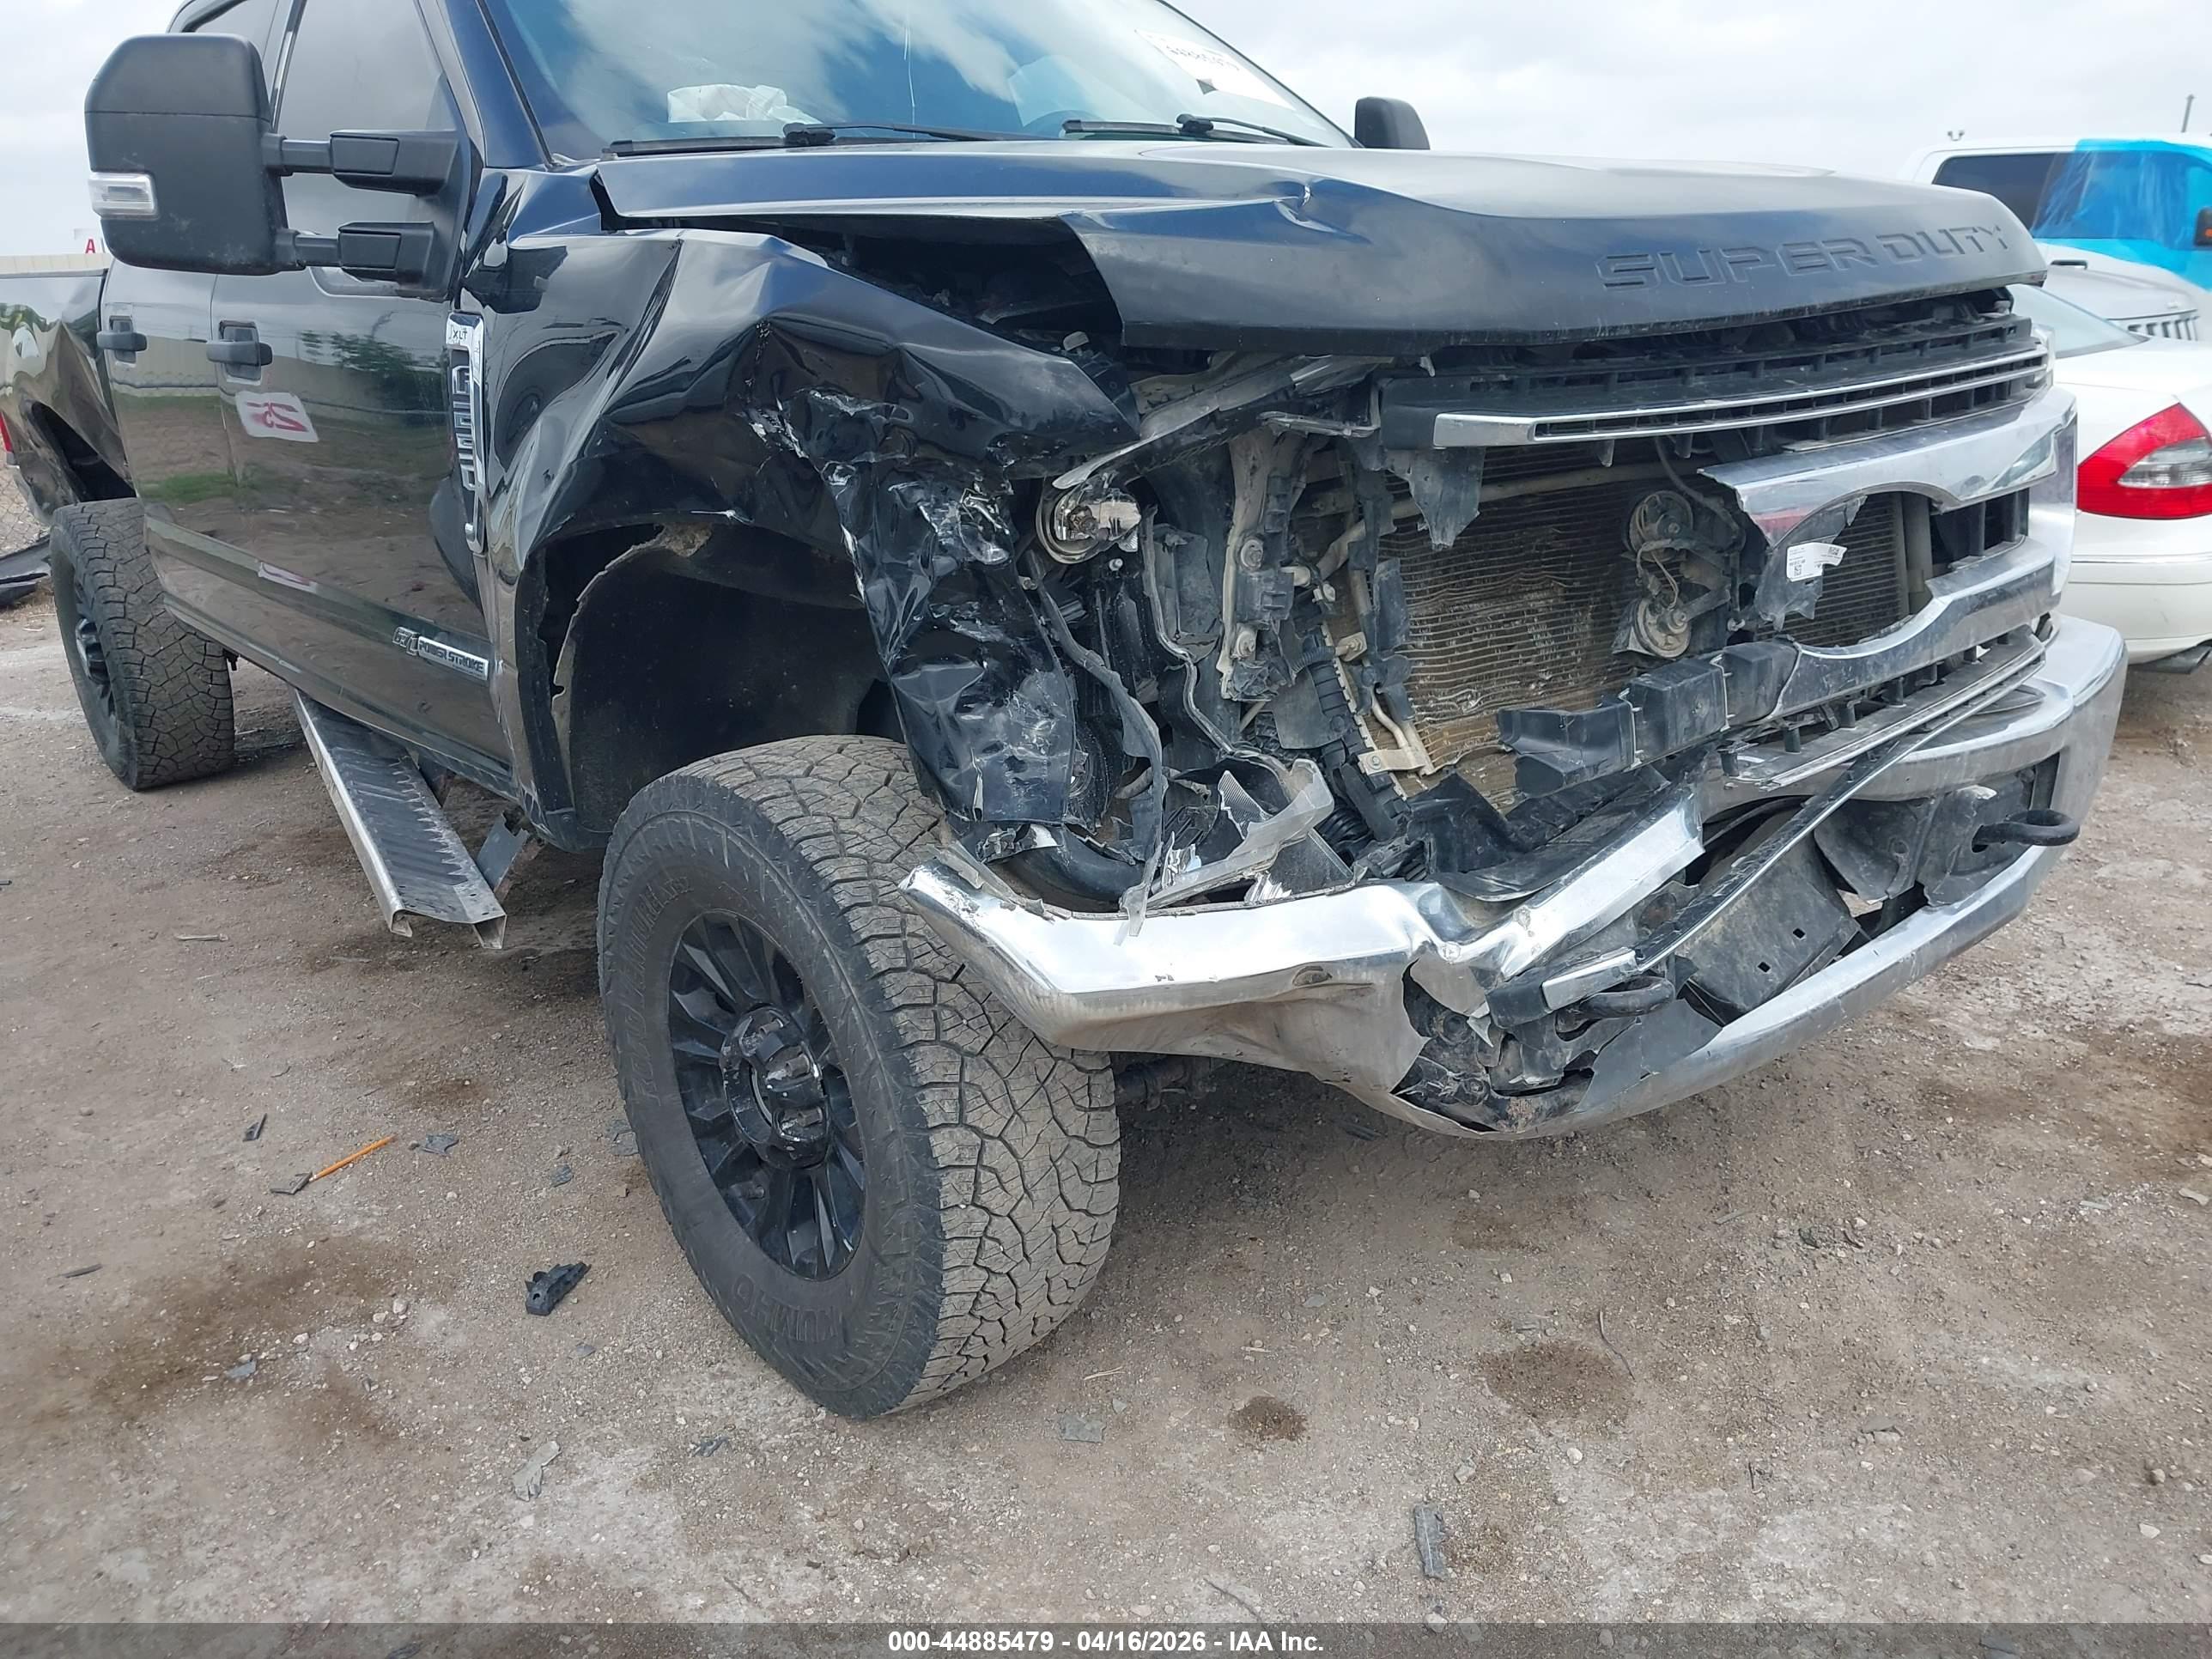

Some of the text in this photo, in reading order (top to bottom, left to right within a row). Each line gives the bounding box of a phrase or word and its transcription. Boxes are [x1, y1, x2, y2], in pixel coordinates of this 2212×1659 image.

[1595, 224, 2008, 290] SUPER DUTY
[453, 330, 468, 340] XLT
[732, 1273, 843, 1342] KUMHO
